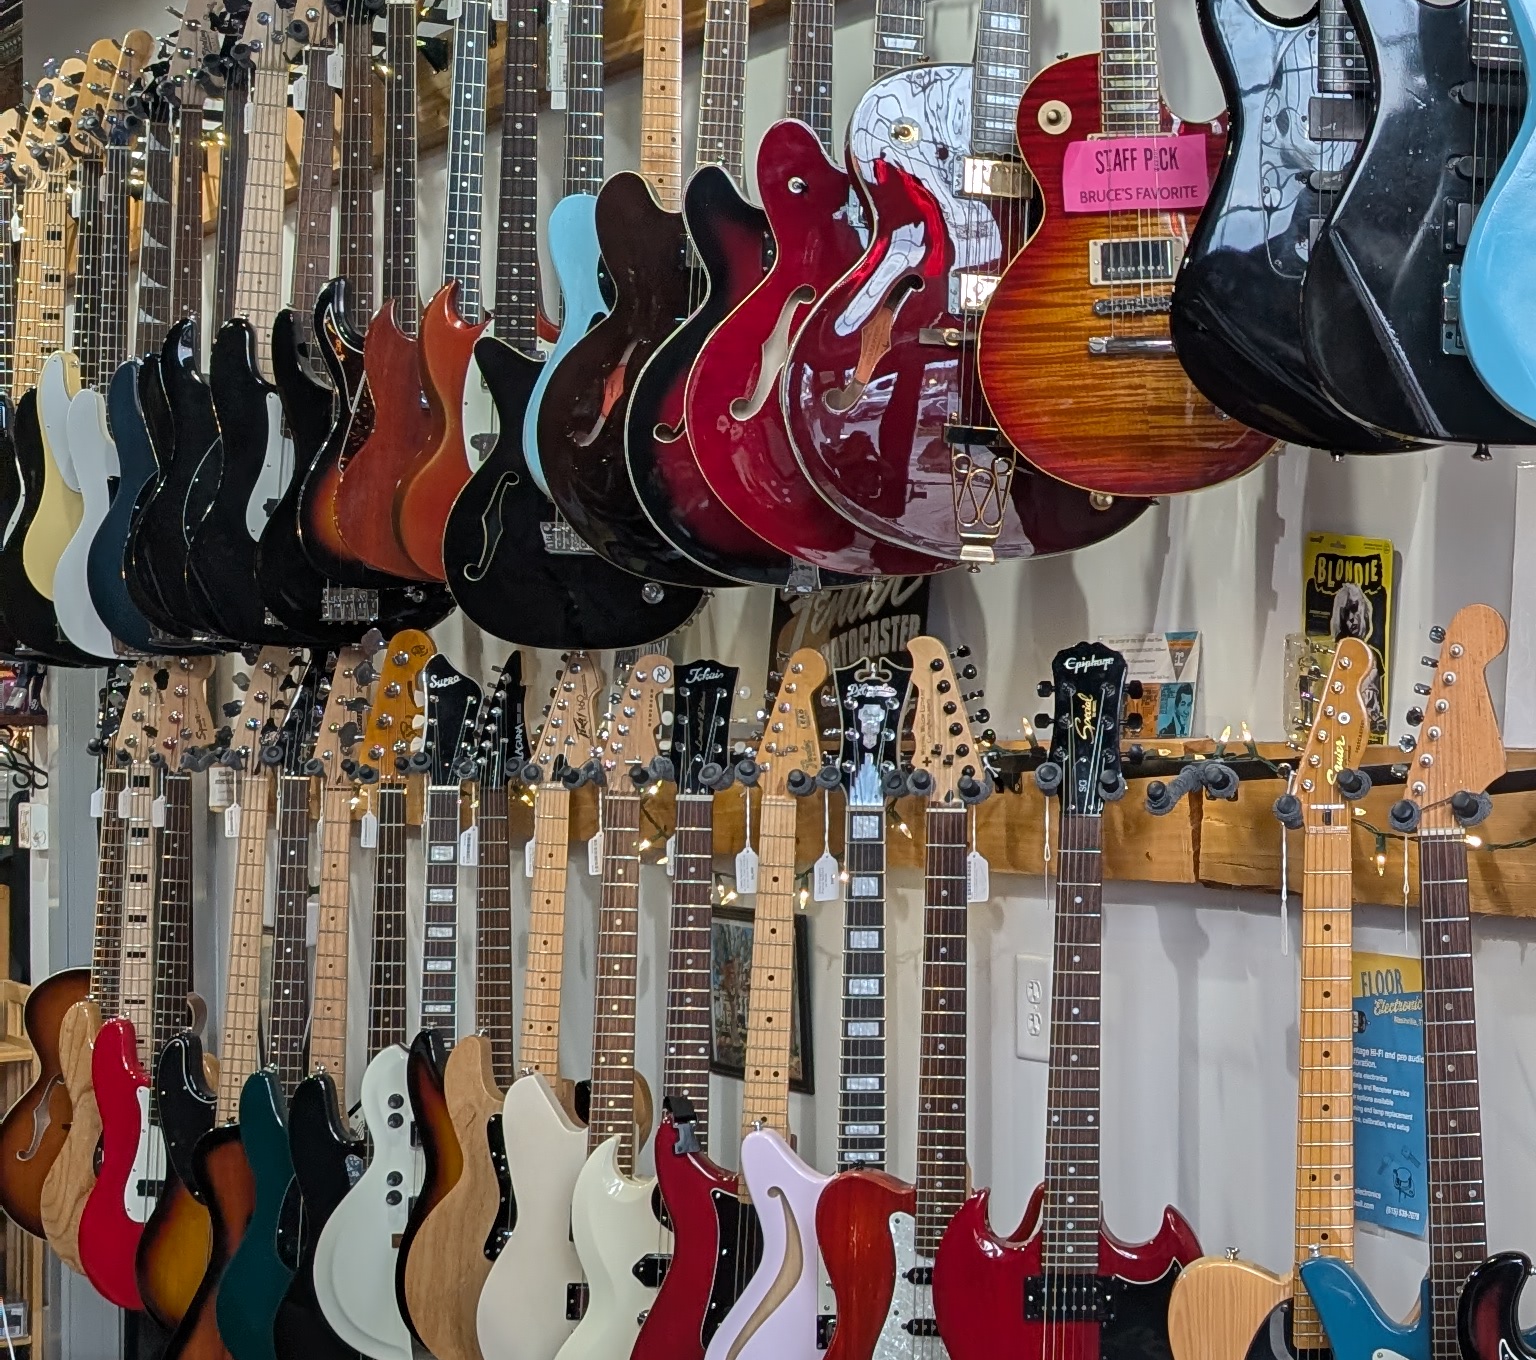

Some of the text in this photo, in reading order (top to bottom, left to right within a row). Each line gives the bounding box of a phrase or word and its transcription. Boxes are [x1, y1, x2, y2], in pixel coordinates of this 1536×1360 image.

[1095, 146, 1180, 175] STAFF PICK
[1079, 185, 1199, 205] BRUCE'S FAVORITE
[1316, 556, 1379, 588] BLONDIE
[820, 613, 921, 676] RATOCASTER
[1064, 654, 1115, 674] Epiphone
[429, 674, 461, 688] Supro
[1074, 692, 1096, 745] Special
[515, 722, 524, 759] LAGUNA
[1361, 968, 1404, 997] FLOOR
[1374, 997, 1423, 1016] Electronic
